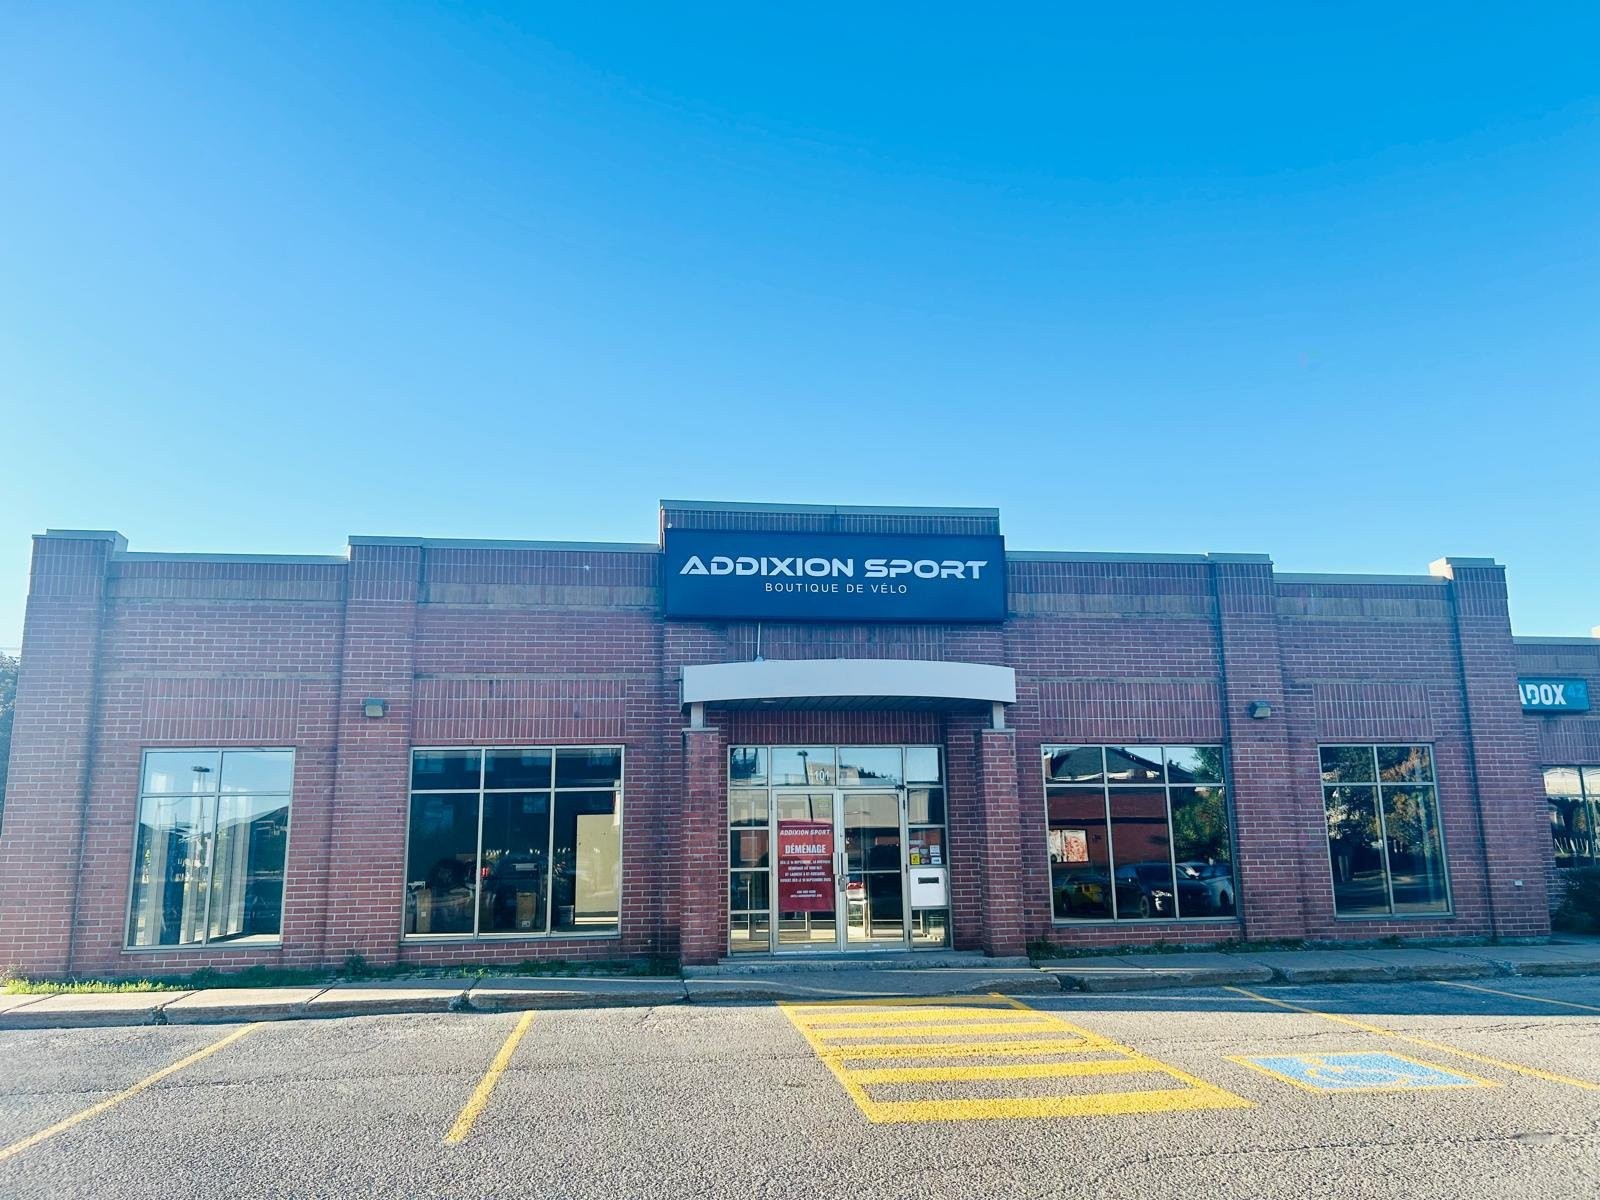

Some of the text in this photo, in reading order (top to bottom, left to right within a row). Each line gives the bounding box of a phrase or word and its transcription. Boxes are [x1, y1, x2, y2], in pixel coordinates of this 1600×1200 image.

[679, 555, 988, 580] ADDIXION SPORT
[765, 582, 908, 594] BOUTIQUE DE VÉLO
[814, 770, 830, 781] 101
[784, 842, 827, 854] DÉMÉNAGE
